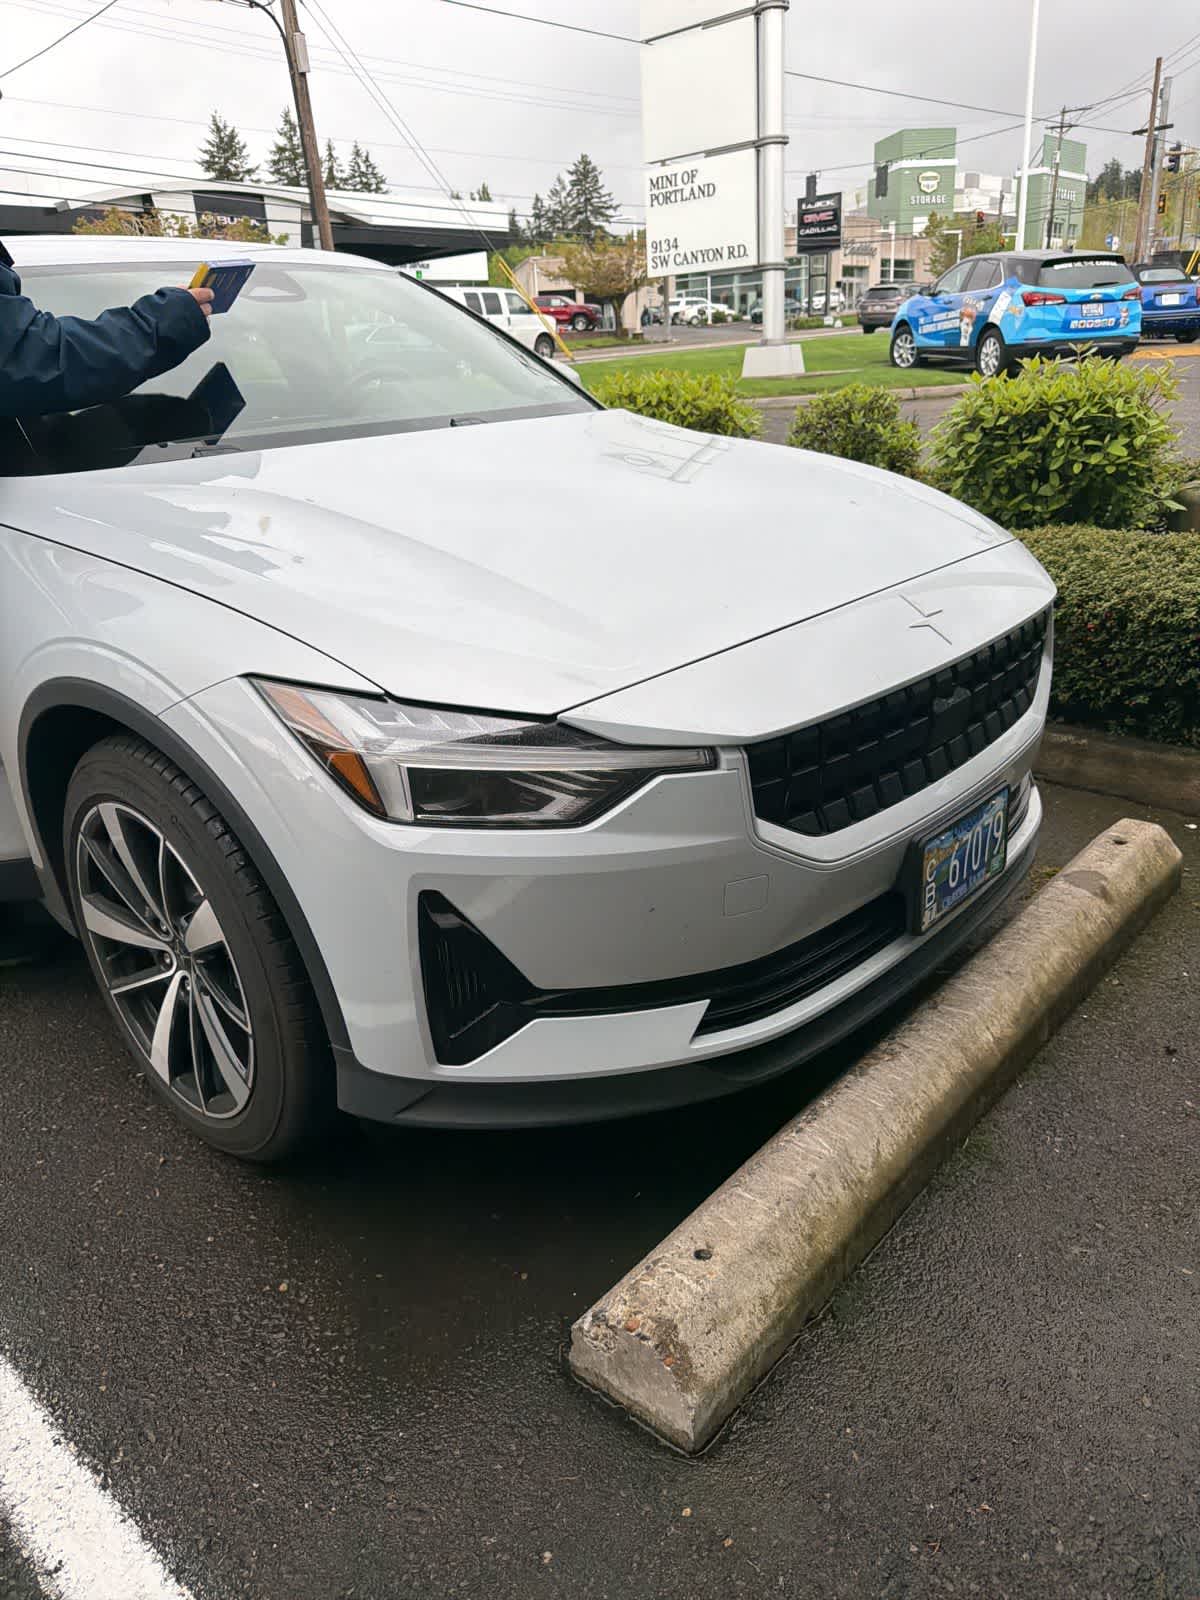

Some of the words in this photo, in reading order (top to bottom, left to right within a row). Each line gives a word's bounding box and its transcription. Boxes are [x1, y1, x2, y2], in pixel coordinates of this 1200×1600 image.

[649, 172, 679, 191] MINI
[681, 169, 698, 185] OF
[649, 183, 716, 207] PORTLAND
[910, 195, 946, 205] STORAGE
[651, 237, 679, 254] 9134
[651, 254, 671, 269] SW
[673, 246, 724, 266] CANYON
[727, 243, 749, 260] RD.
[949, 810, 1004, 888] 67079
